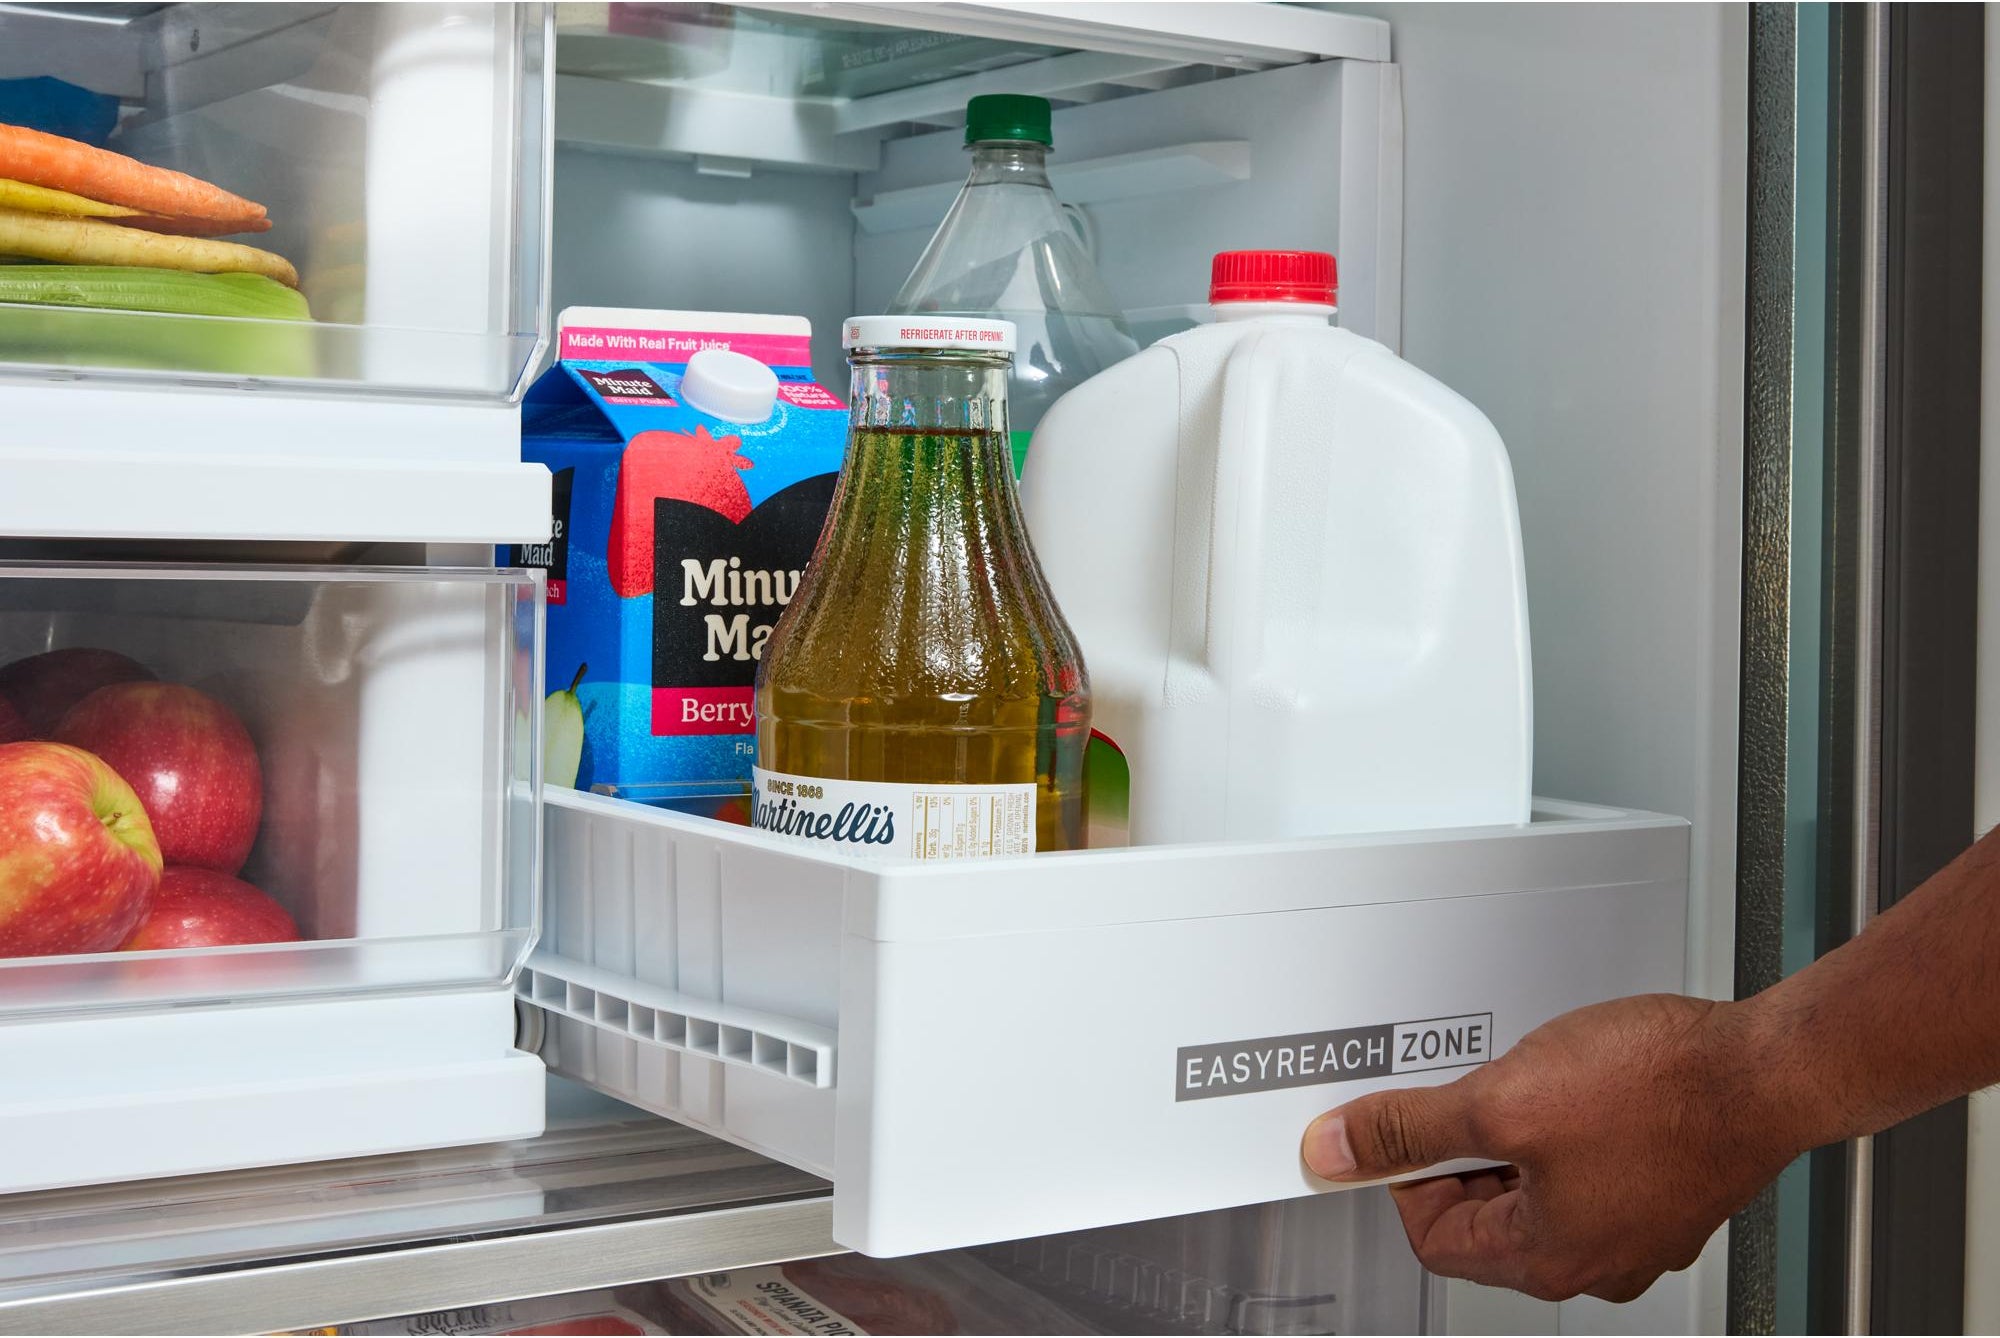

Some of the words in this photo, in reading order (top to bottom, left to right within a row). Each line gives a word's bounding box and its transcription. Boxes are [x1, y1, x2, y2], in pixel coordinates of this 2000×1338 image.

[568, 333, 603, 347] Made
[607, 335, 637, 348] With
[640, 336, 666, 349] Real
[668, 337, 697, 350] Fruit
[700, 339, 729, 351] Juice
[900, 328, 953, 340] REFRIGERATE
[955, 329, 978, 341] AFTER
[980, 330, 1004, 342] OPENING
[592, 376, 653, 388] Minute
[607, 385, 654, 396] Maid
[782, 391, 831, 399] Natural
[789, 397, 838, 406] Flavors
[679, 556, 806, 606] Minu
[702, 614, 777, 661] Ma
[680, 698, 754, 727] Berry
[767, 778, 794, 796] SINCE
[796, 784, 824, 800] 1868
[1186, 1037, 1385, 1089] EASYREACH
[1400, 1025, 1482, 1063] ZONE
[756, 1281, 829, 1323] SPIANATA
